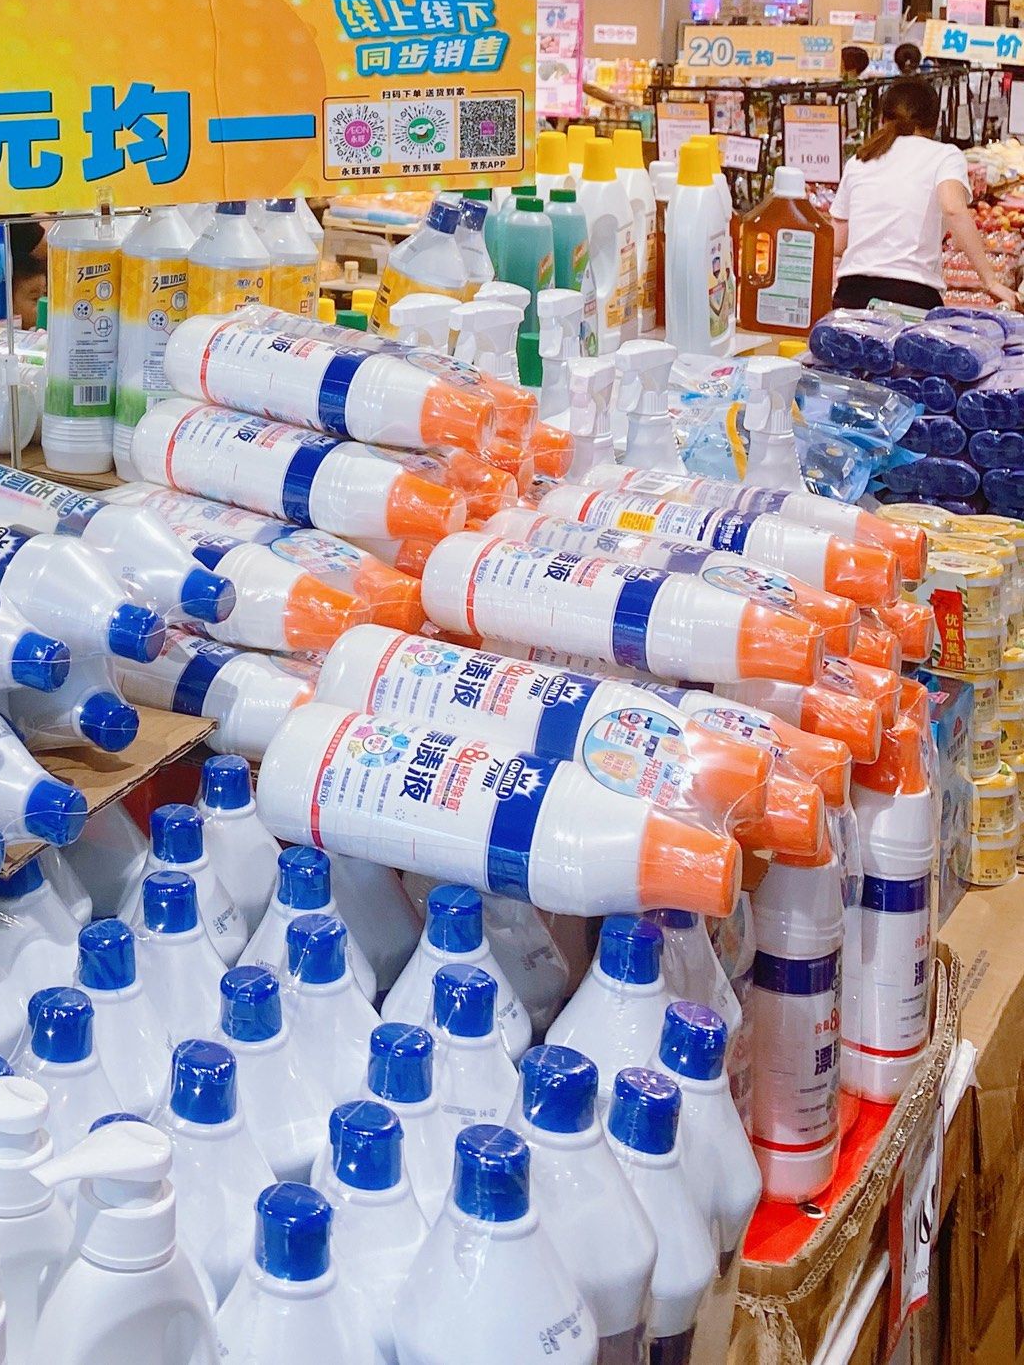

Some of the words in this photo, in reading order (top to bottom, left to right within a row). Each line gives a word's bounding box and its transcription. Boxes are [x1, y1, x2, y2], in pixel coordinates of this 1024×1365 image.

[942, 28, 1022, 58] 均一价
[360, 36, 504, 72] 同步销售
[382, 89, 423, 100] 扫码下单
[425, 87, 466, 98] 送货到家
[470, 160, 506, 170] 京东APP
[799, 153, 831, 165] 10.00
[341, 166, 381, 176] 永旺到家
[402, 163, 442, 173] 京东到家
[481, 757, 504, 789] 万丽
[497, 759, 524, 799] WANLI
